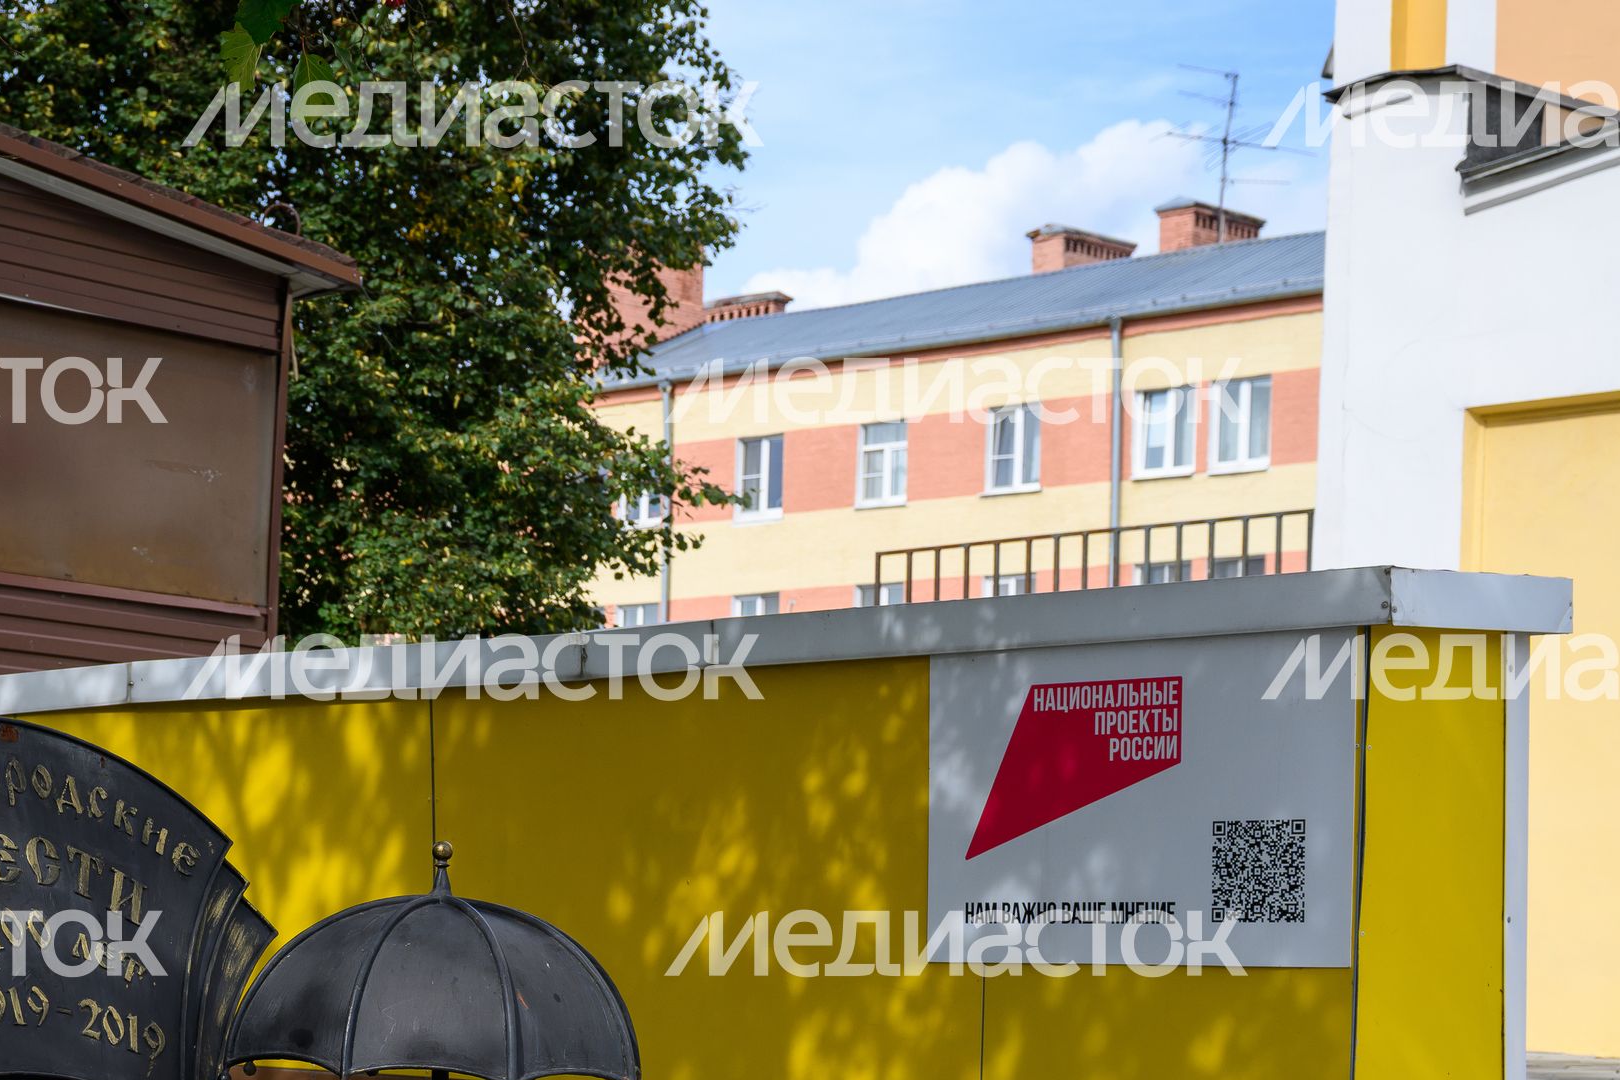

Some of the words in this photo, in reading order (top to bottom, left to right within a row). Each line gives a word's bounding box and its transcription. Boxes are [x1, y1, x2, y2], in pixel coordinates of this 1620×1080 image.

[1033, 680, 1179, 713] НАЦИОНАЛЬНЫЕ
[1094, 708, 1179, 736] ПРОЕКТЫ
[1109, 735, 1178, 762] РОССИИ
[965, 902, 997, 924] НАМ
[1001, 902, 1057, 924] ВАЖНО
[1061, 902, 1107, 924] ВАШЕ
[1111, 902, 1176, 924] МНЕНИЕ
